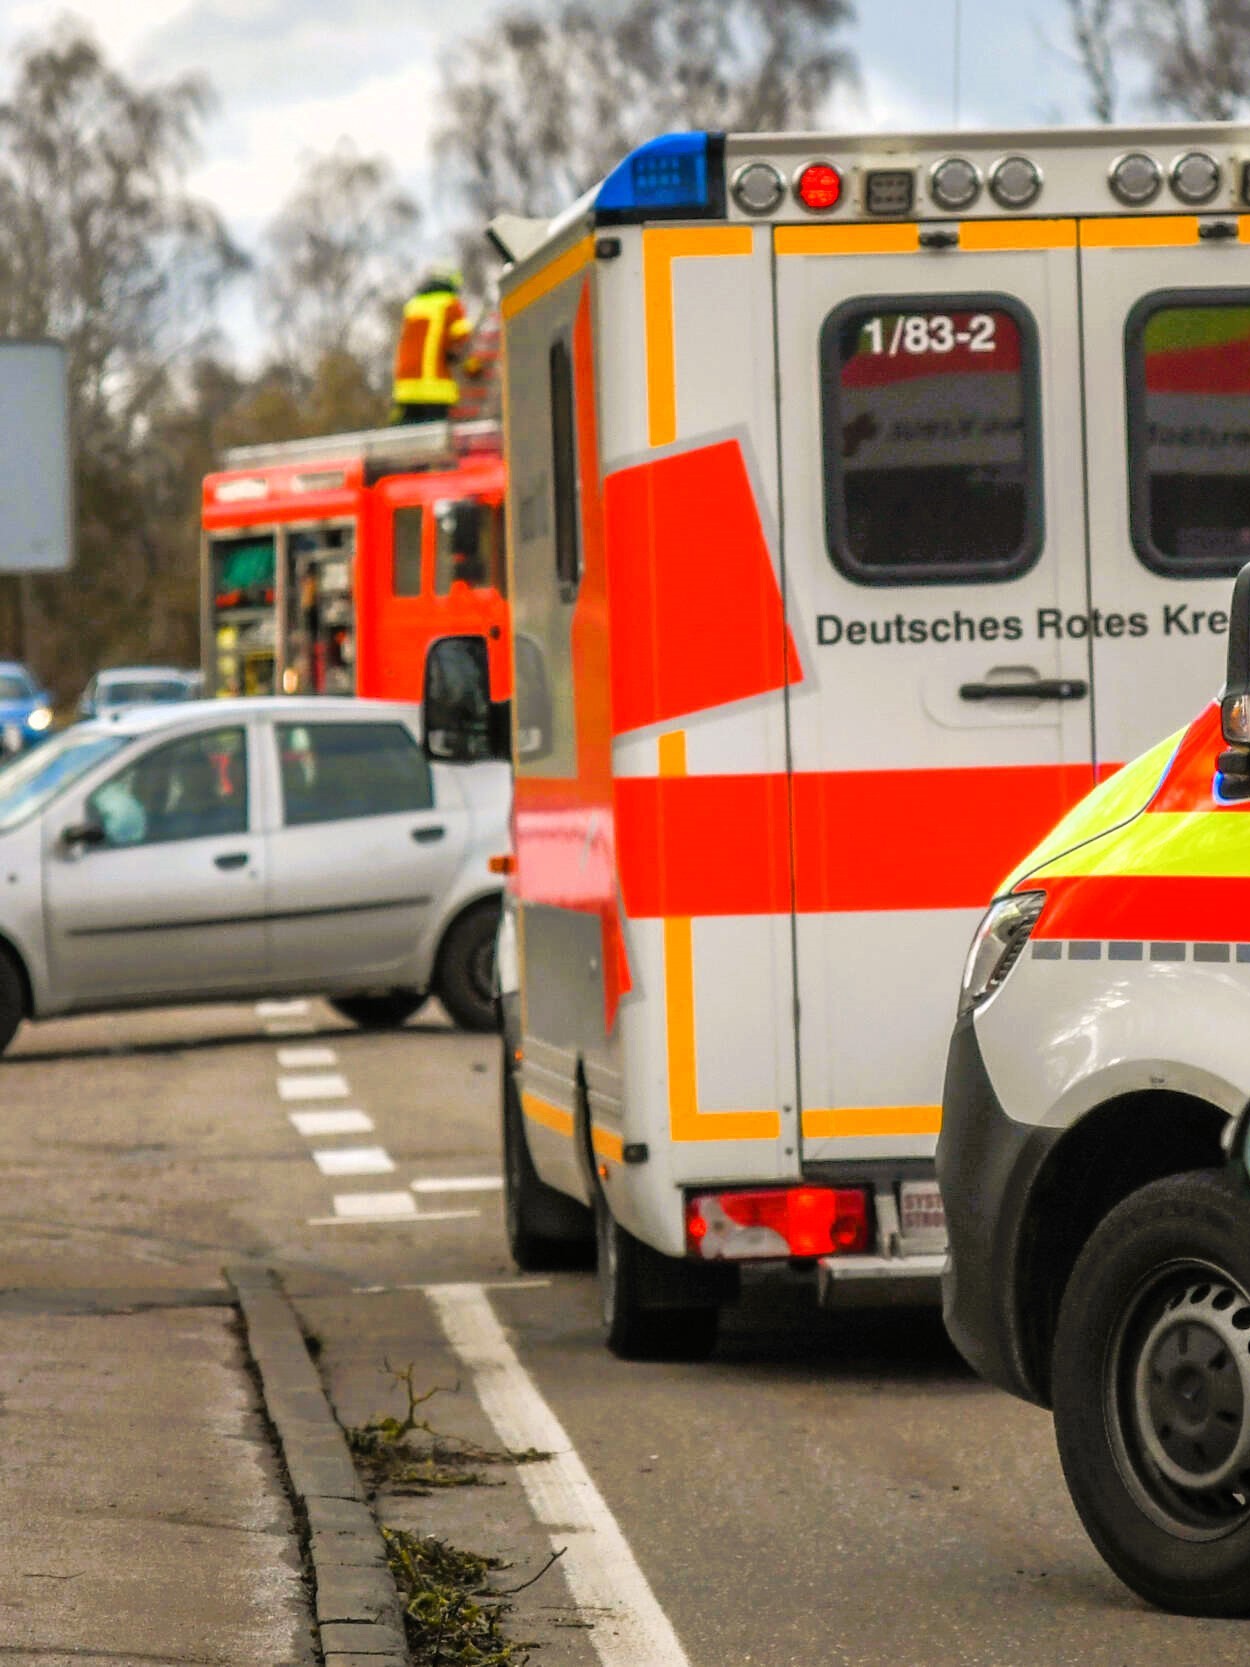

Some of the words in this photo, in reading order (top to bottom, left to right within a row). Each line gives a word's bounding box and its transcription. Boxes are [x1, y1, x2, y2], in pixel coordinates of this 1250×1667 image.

[862, 314, 997, 358] 1/83-2
[817, 611, 1023, 646] Deutsches
[1037, 608, 1149, 639] Rotes
[1163, 604, 1228, 636] Kre
